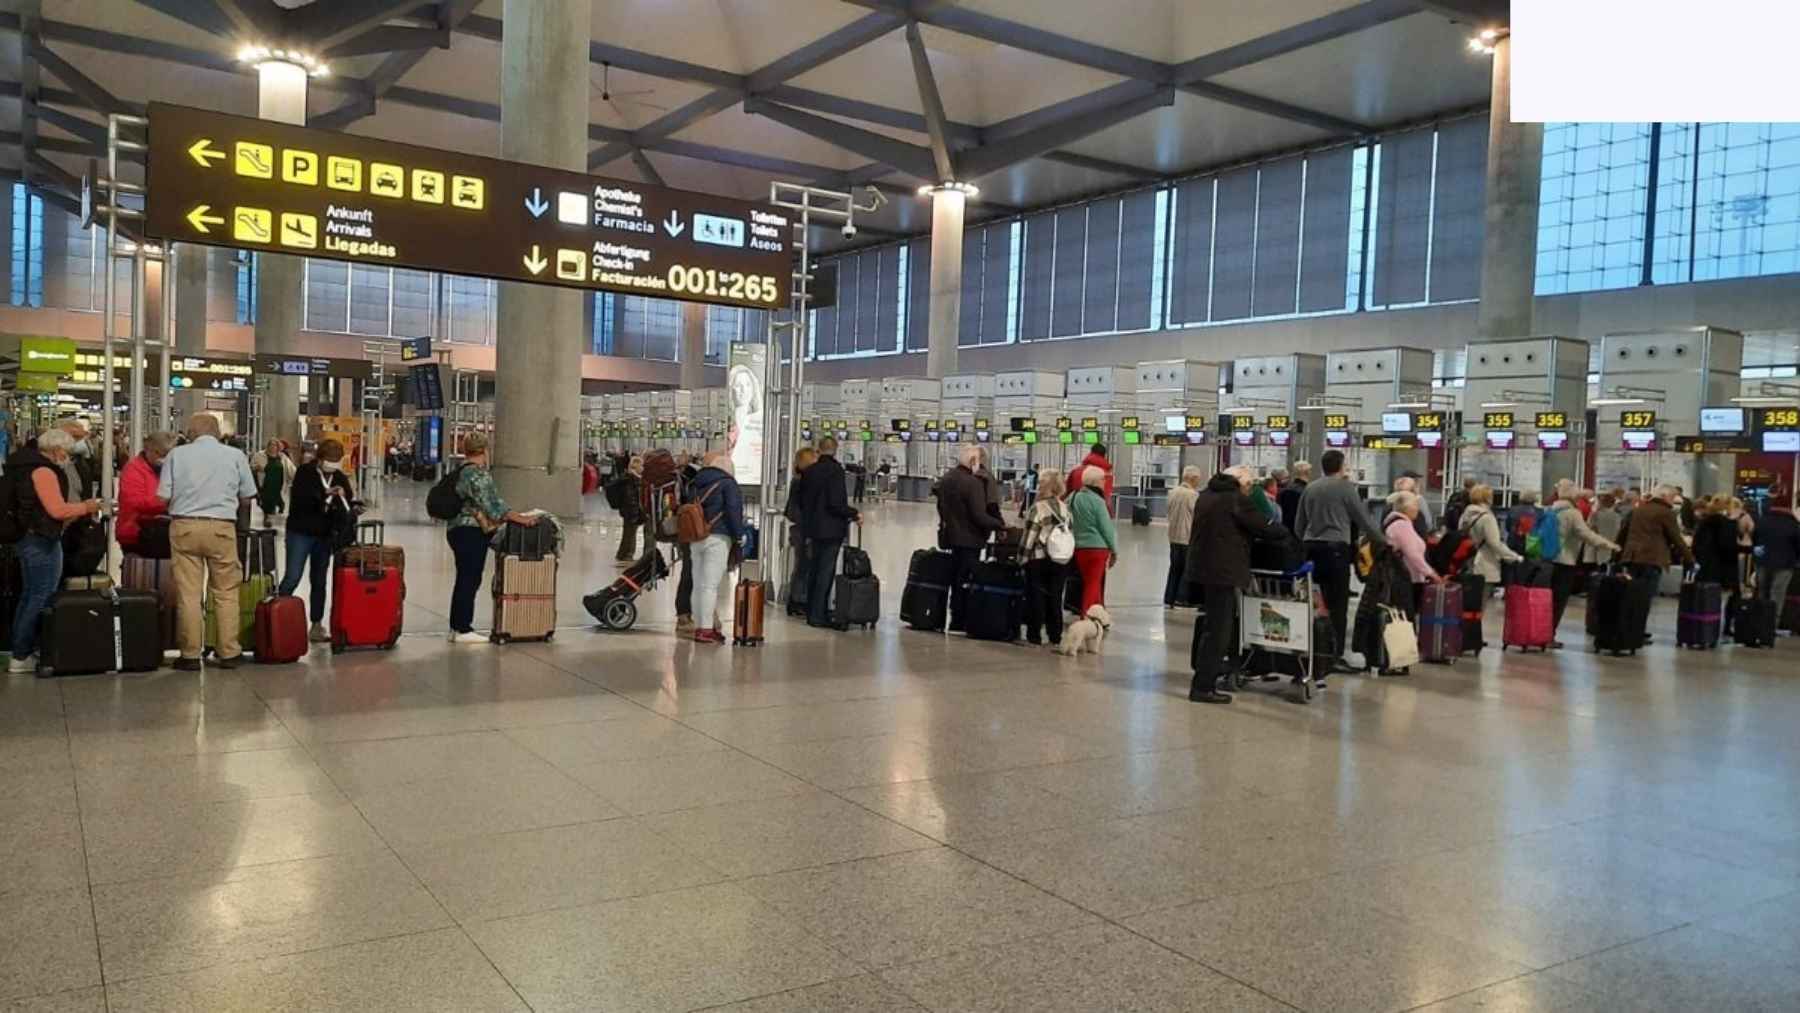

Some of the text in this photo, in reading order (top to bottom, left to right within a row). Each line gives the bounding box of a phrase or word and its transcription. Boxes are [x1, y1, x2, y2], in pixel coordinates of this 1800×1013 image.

[594, 185, 642, 204] Apotheke
[326, 204, 373, 222] Ankunft
[594, 199, 643, 217] Chemist's
[326, 221, 373, 237] Arrivals
[594, 213, 655, 233] Farmacia
[750, 223, 779, 238] Toilets
[325, 236, 397, 258] Llegadas
[593, 241, 651, 262] Abfertigung
[750, 236, 783, 252] Aseos
[592, 255, 635, 271] Check-in
[592, 268, 667, 290] Facturación
[668, 264, 718, 296] 001
[728, 272, 778, 302] 265
[1326, 416, 1345, 428] 353
[1416, 415, 1439, 428] 354
[1486, 414, 1511, 427] 355
[1537, 414, 1564, 427] 356
[1623, 413, 1652, 426] 357
[1764, 411, 1798, 426] 358
